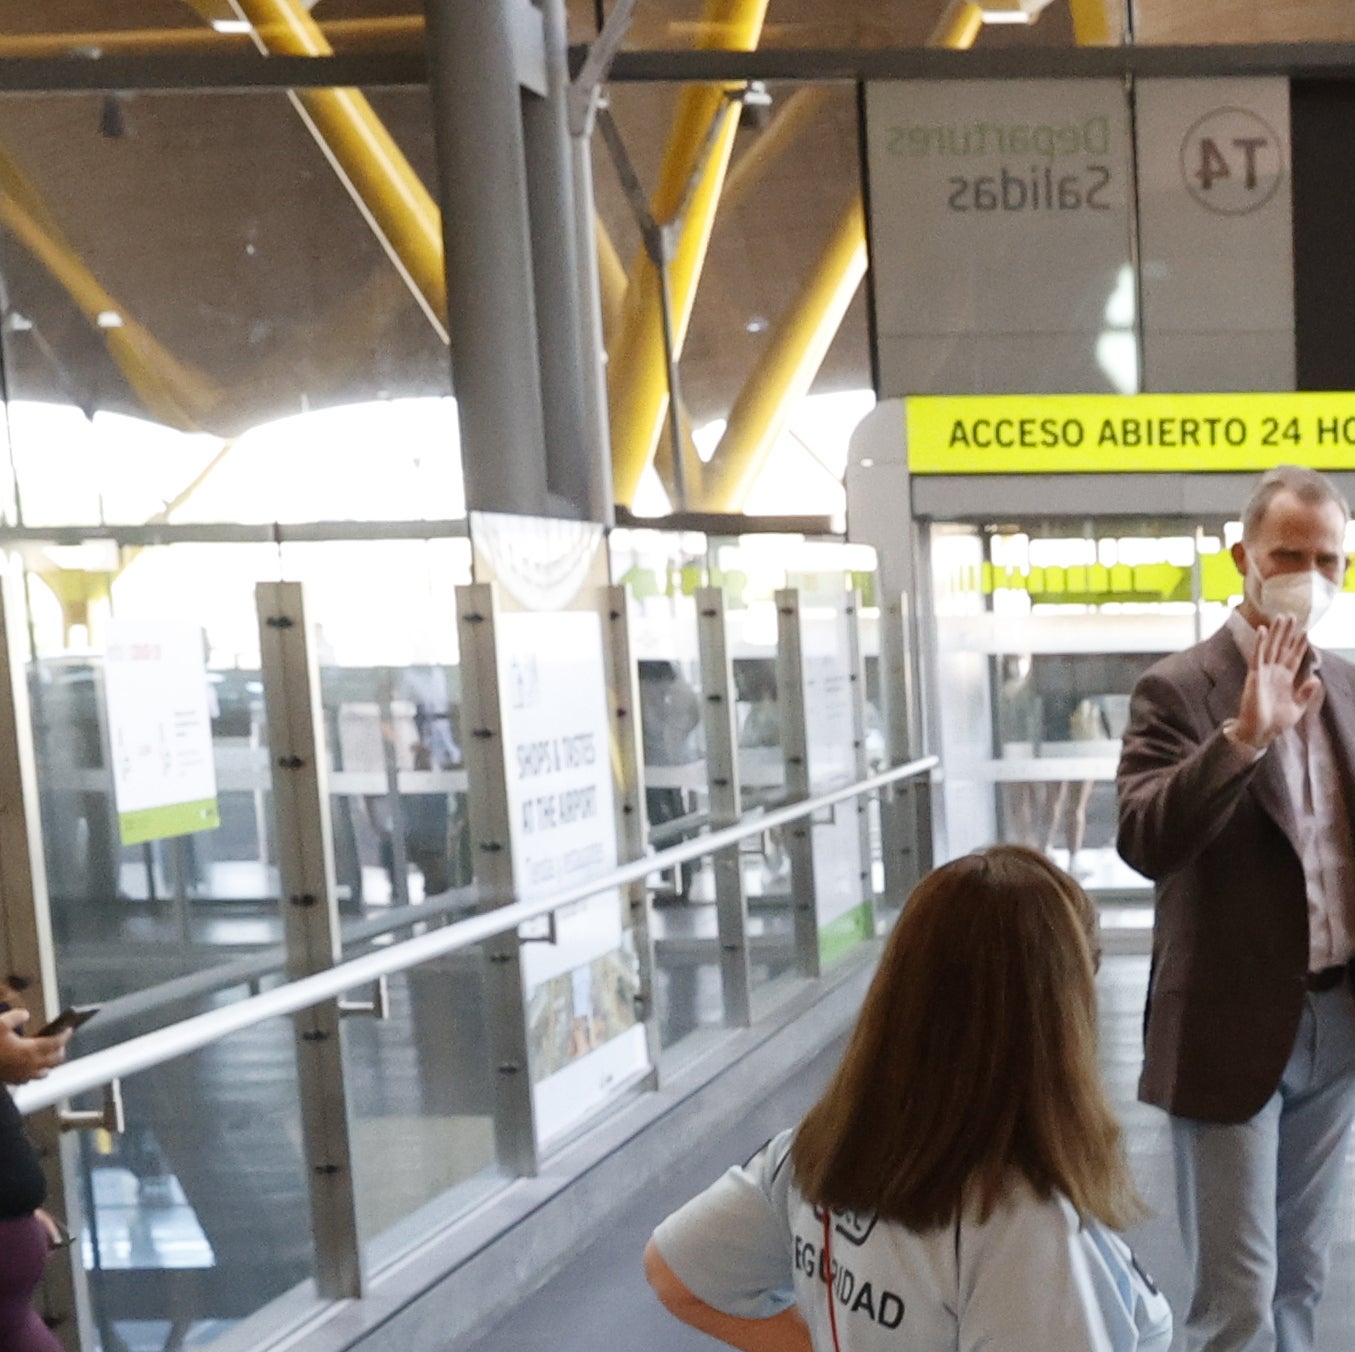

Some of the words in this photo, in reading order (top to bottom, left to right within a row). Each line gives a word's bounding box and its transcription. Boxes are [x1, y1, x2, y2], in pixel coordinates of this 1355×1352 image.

[948, 418, 1085, 449] ACCESO
[1097, 416, 1247, 448] ABIERTO
[1259, 416, 1302, 447] 24
